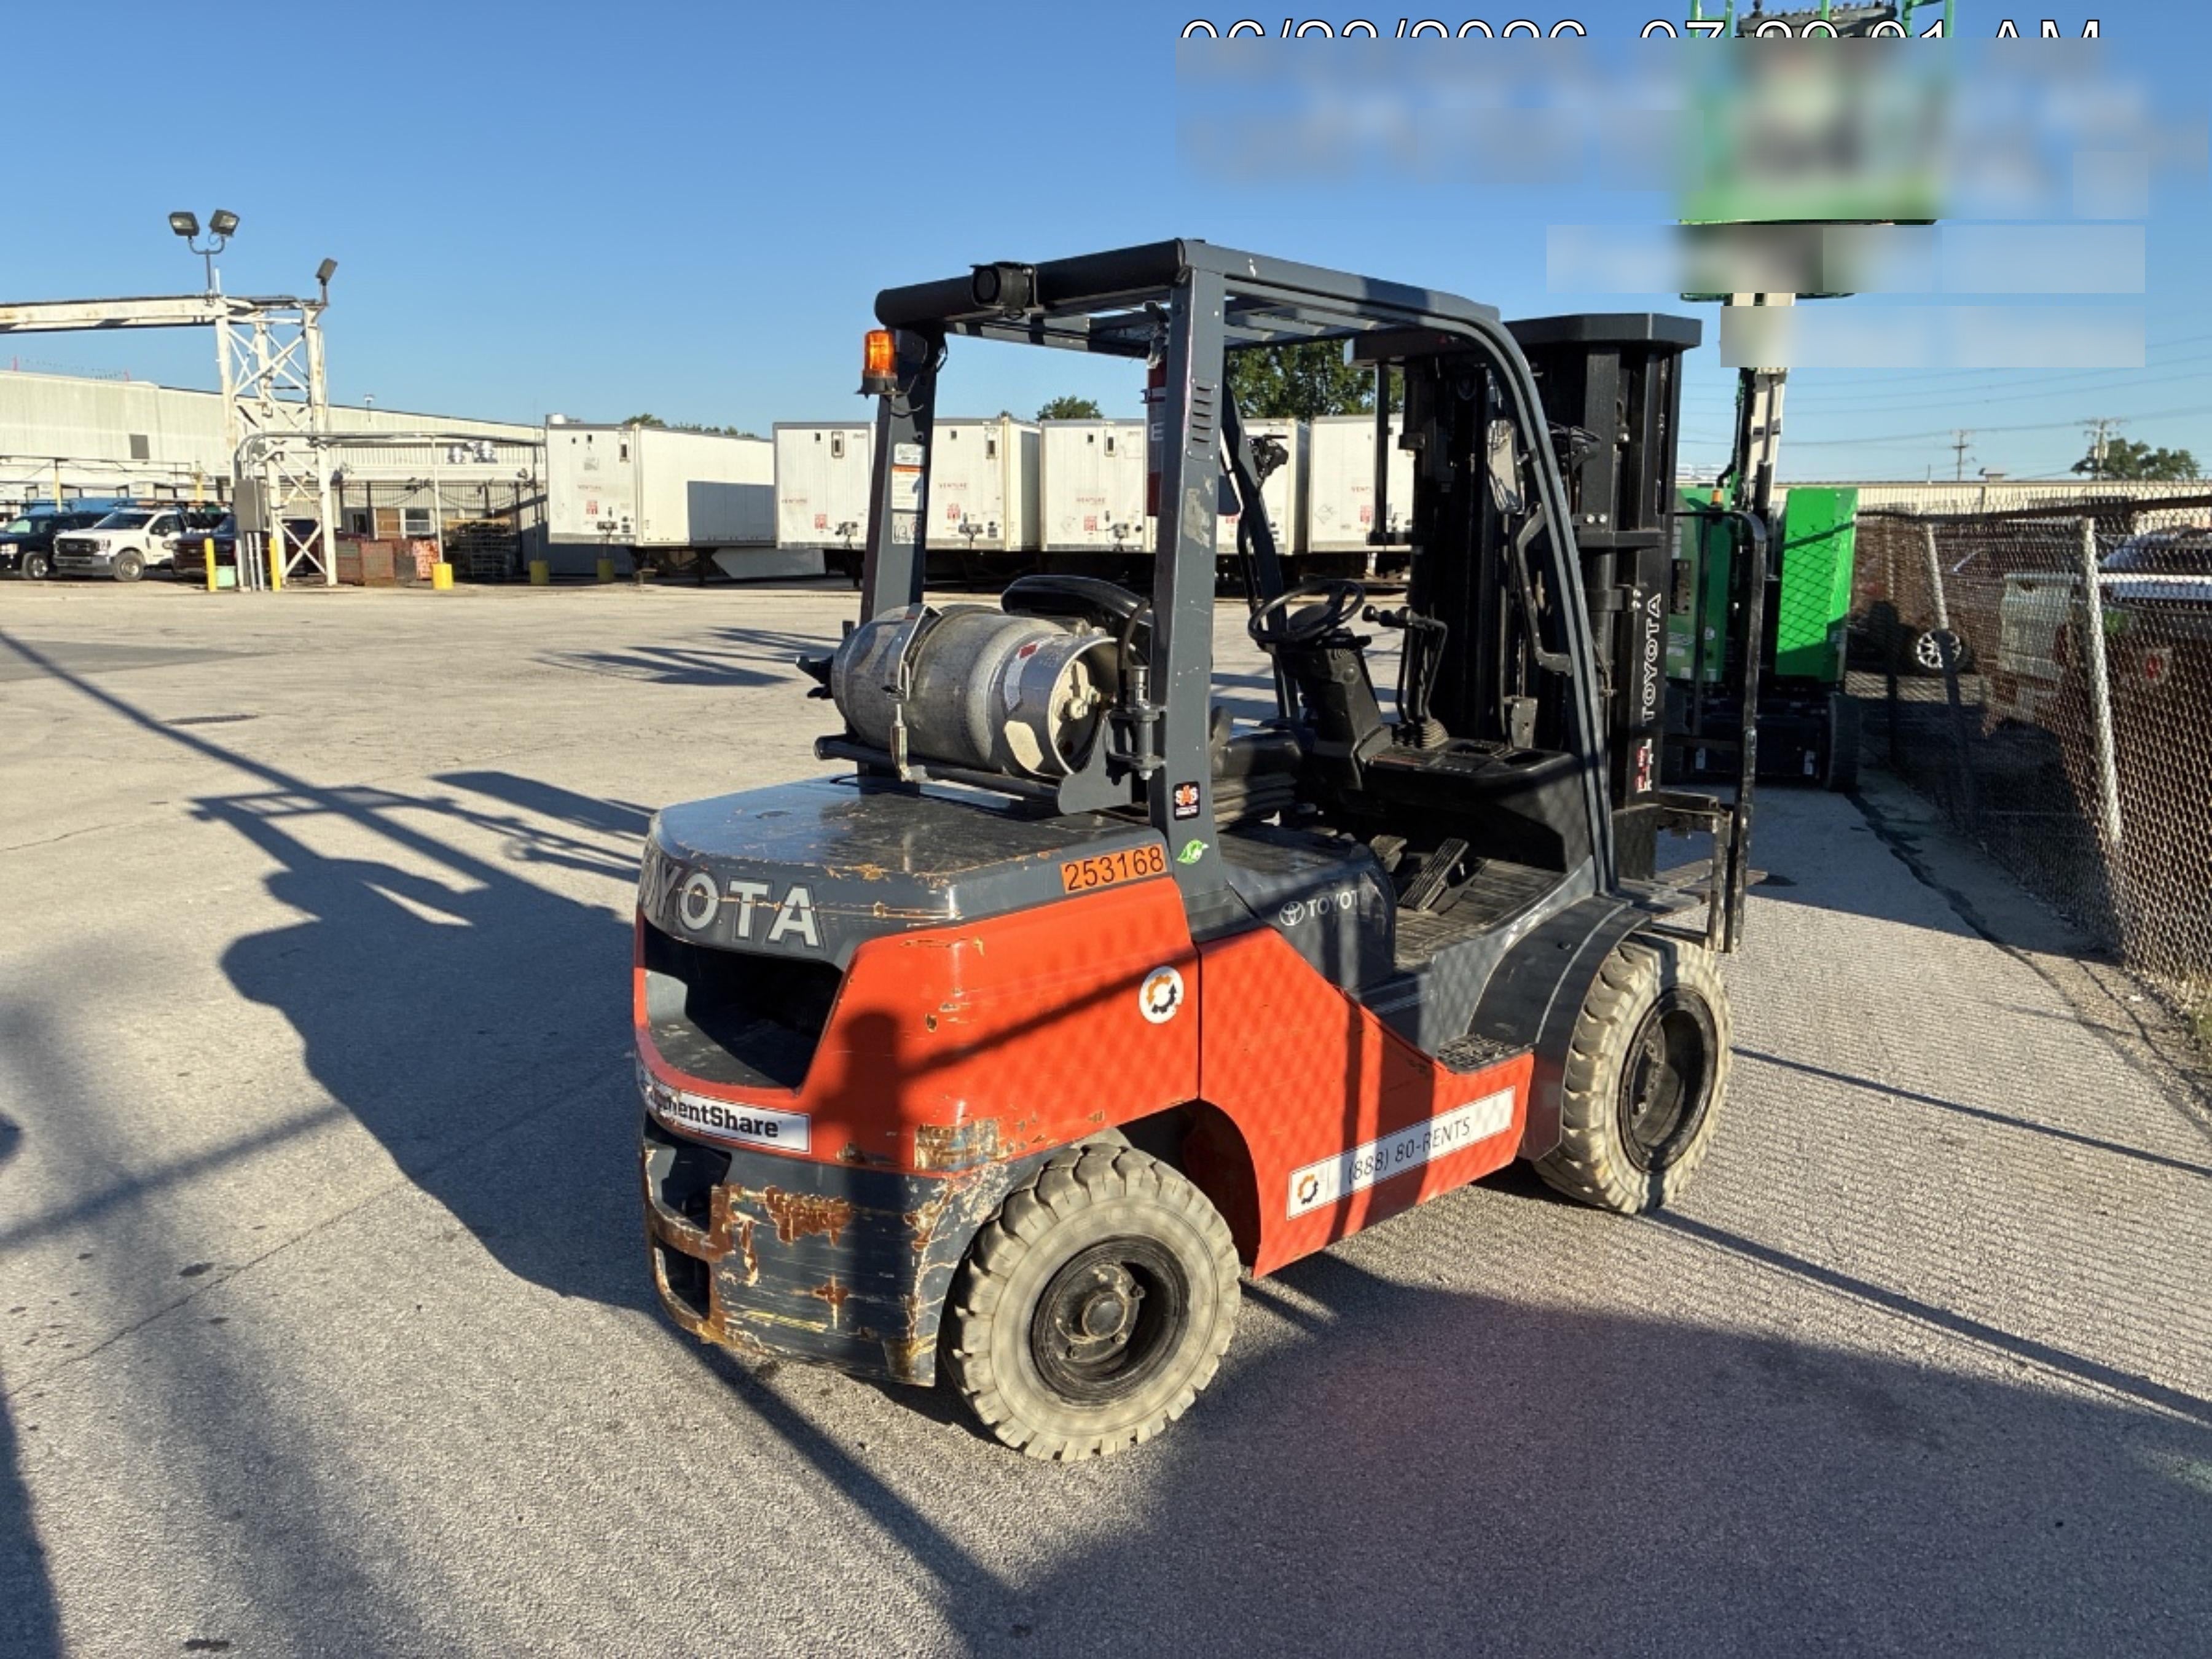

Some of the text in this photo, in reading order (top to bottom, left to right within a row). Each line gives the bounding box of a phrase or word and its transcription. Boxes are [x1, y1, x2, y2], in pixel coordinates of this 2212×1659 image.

[1641, 593, 1662, 727] TOYOTA
[1064, 845, 1164, 891] 253168
[1348, 1116, 1471, 1185] (888) 80-RENTS
